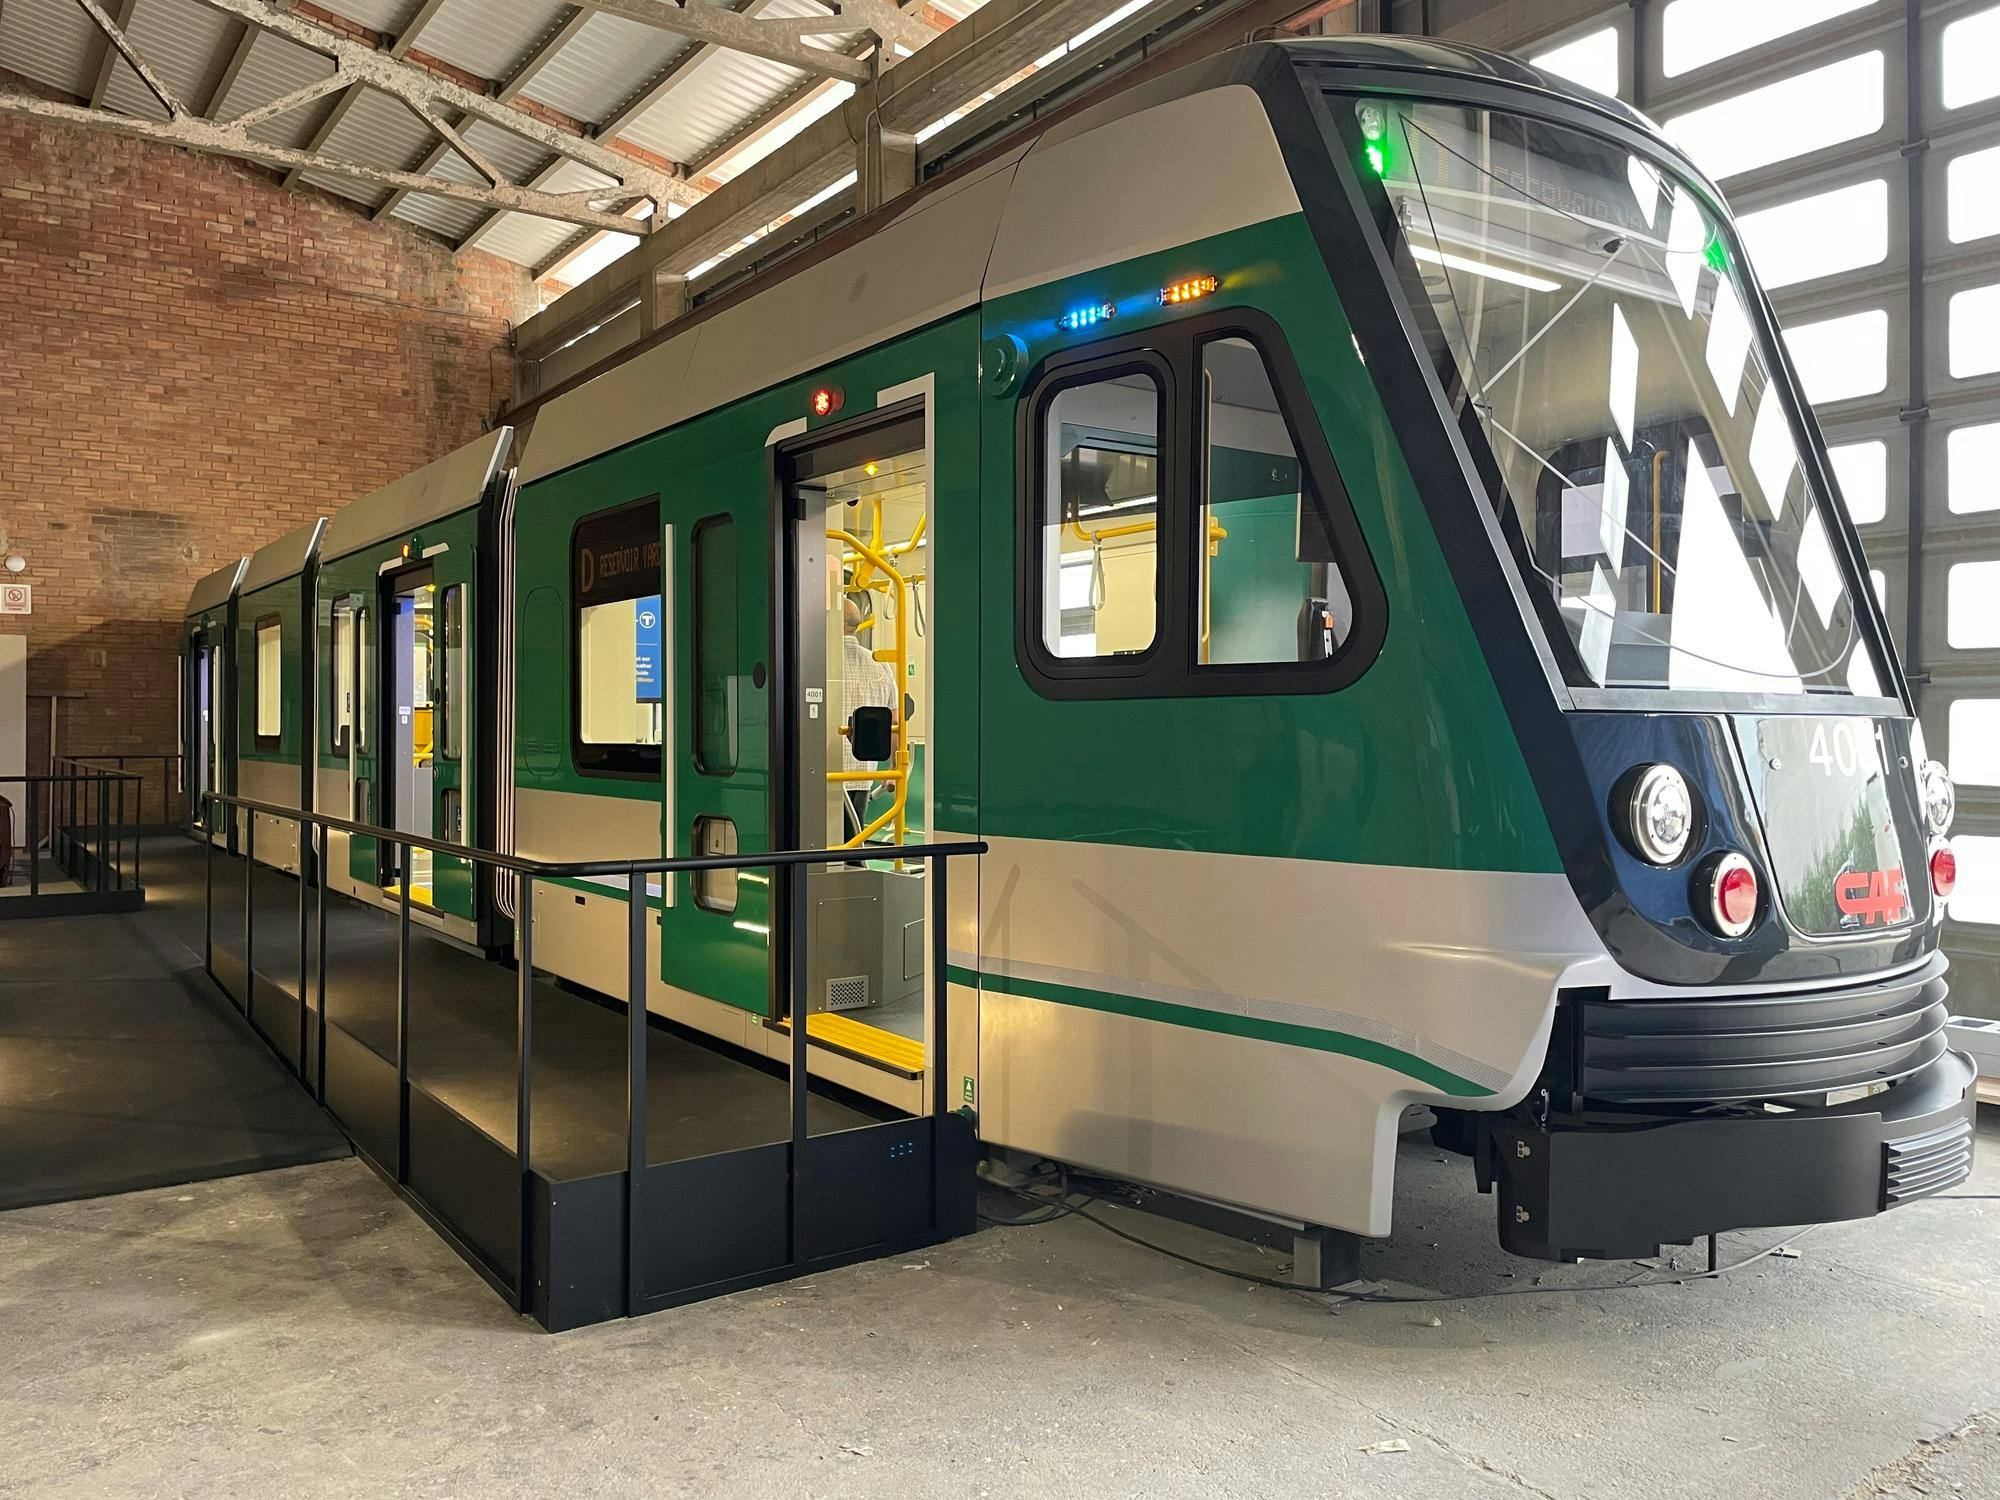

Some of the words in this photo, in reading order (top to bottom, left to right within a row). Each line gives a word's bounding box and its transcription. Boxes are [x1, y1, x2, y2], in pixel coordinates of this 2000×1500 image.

[580, 548, 595, 593] D
[600, 545, 640, 578] RESERVOIR
[1809, 722, 1890, 777] 401
